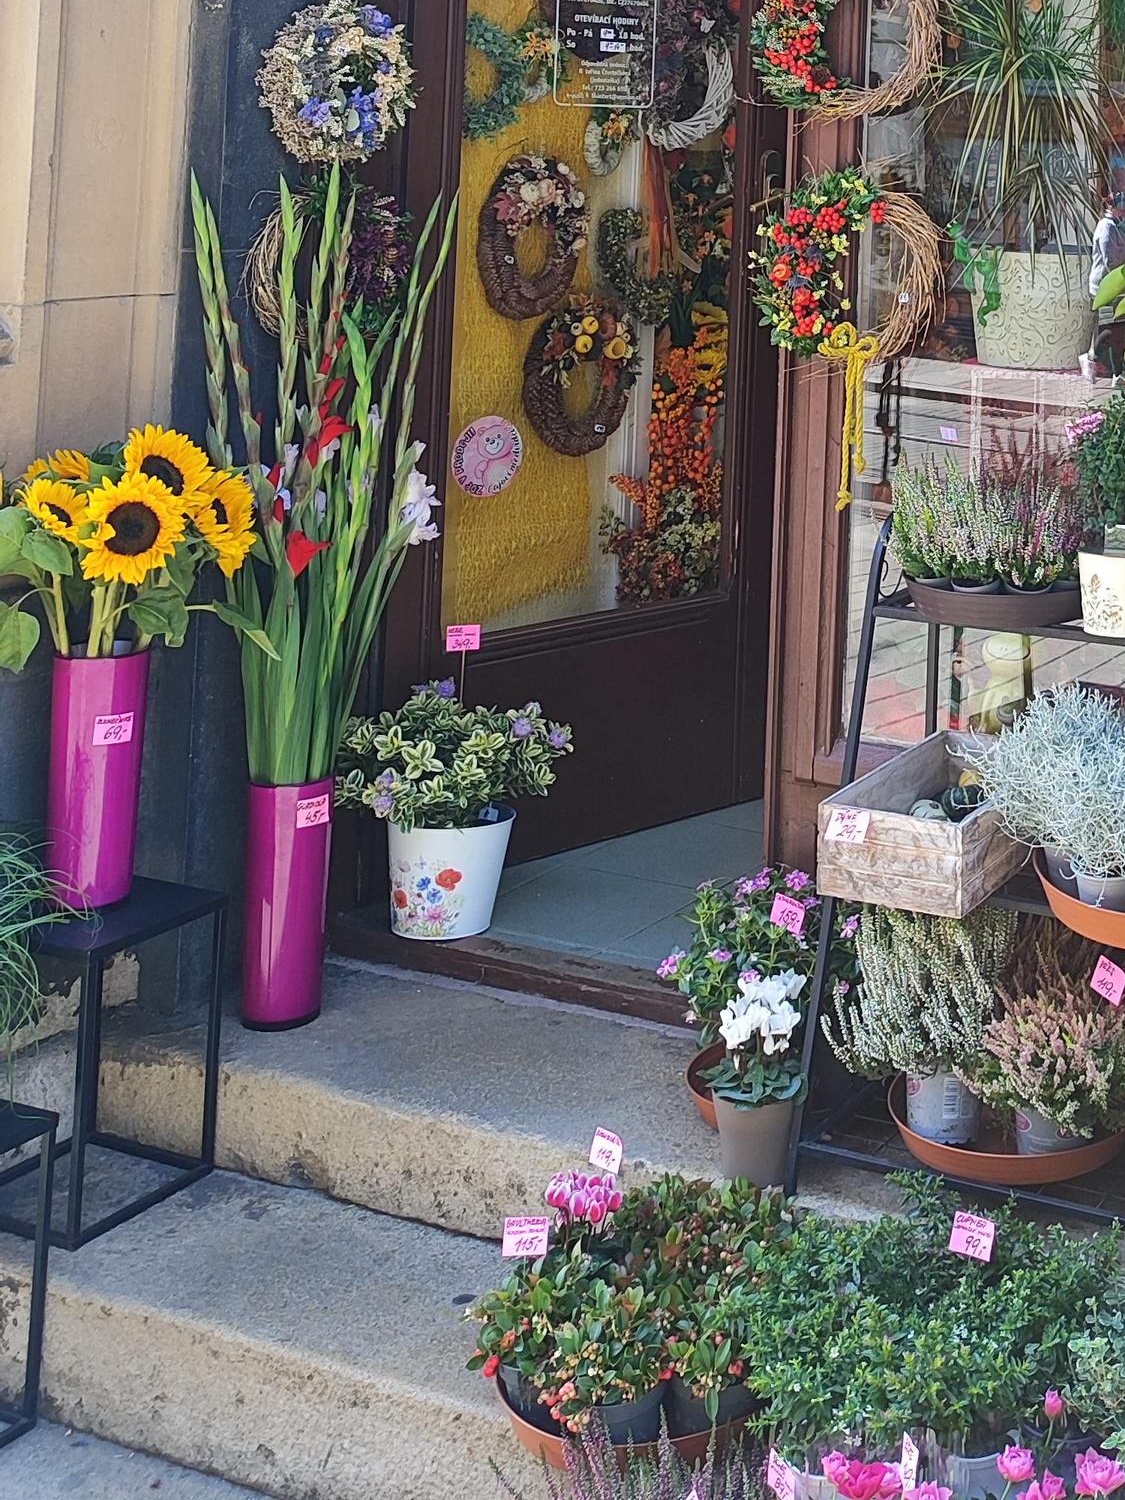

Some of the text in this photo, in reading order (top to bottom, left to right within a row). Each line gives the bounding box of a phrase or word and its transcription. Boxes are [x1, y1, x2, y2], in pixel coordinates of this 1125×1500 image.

[574, 13, 640, 26] OTEVÍRACÍ HODINY
[566, 27, 576, 36] Po
[583, 28, 593, 38] Pá
[630, 32, 646, 41] hod.
[566, 40, 576, 48] So
